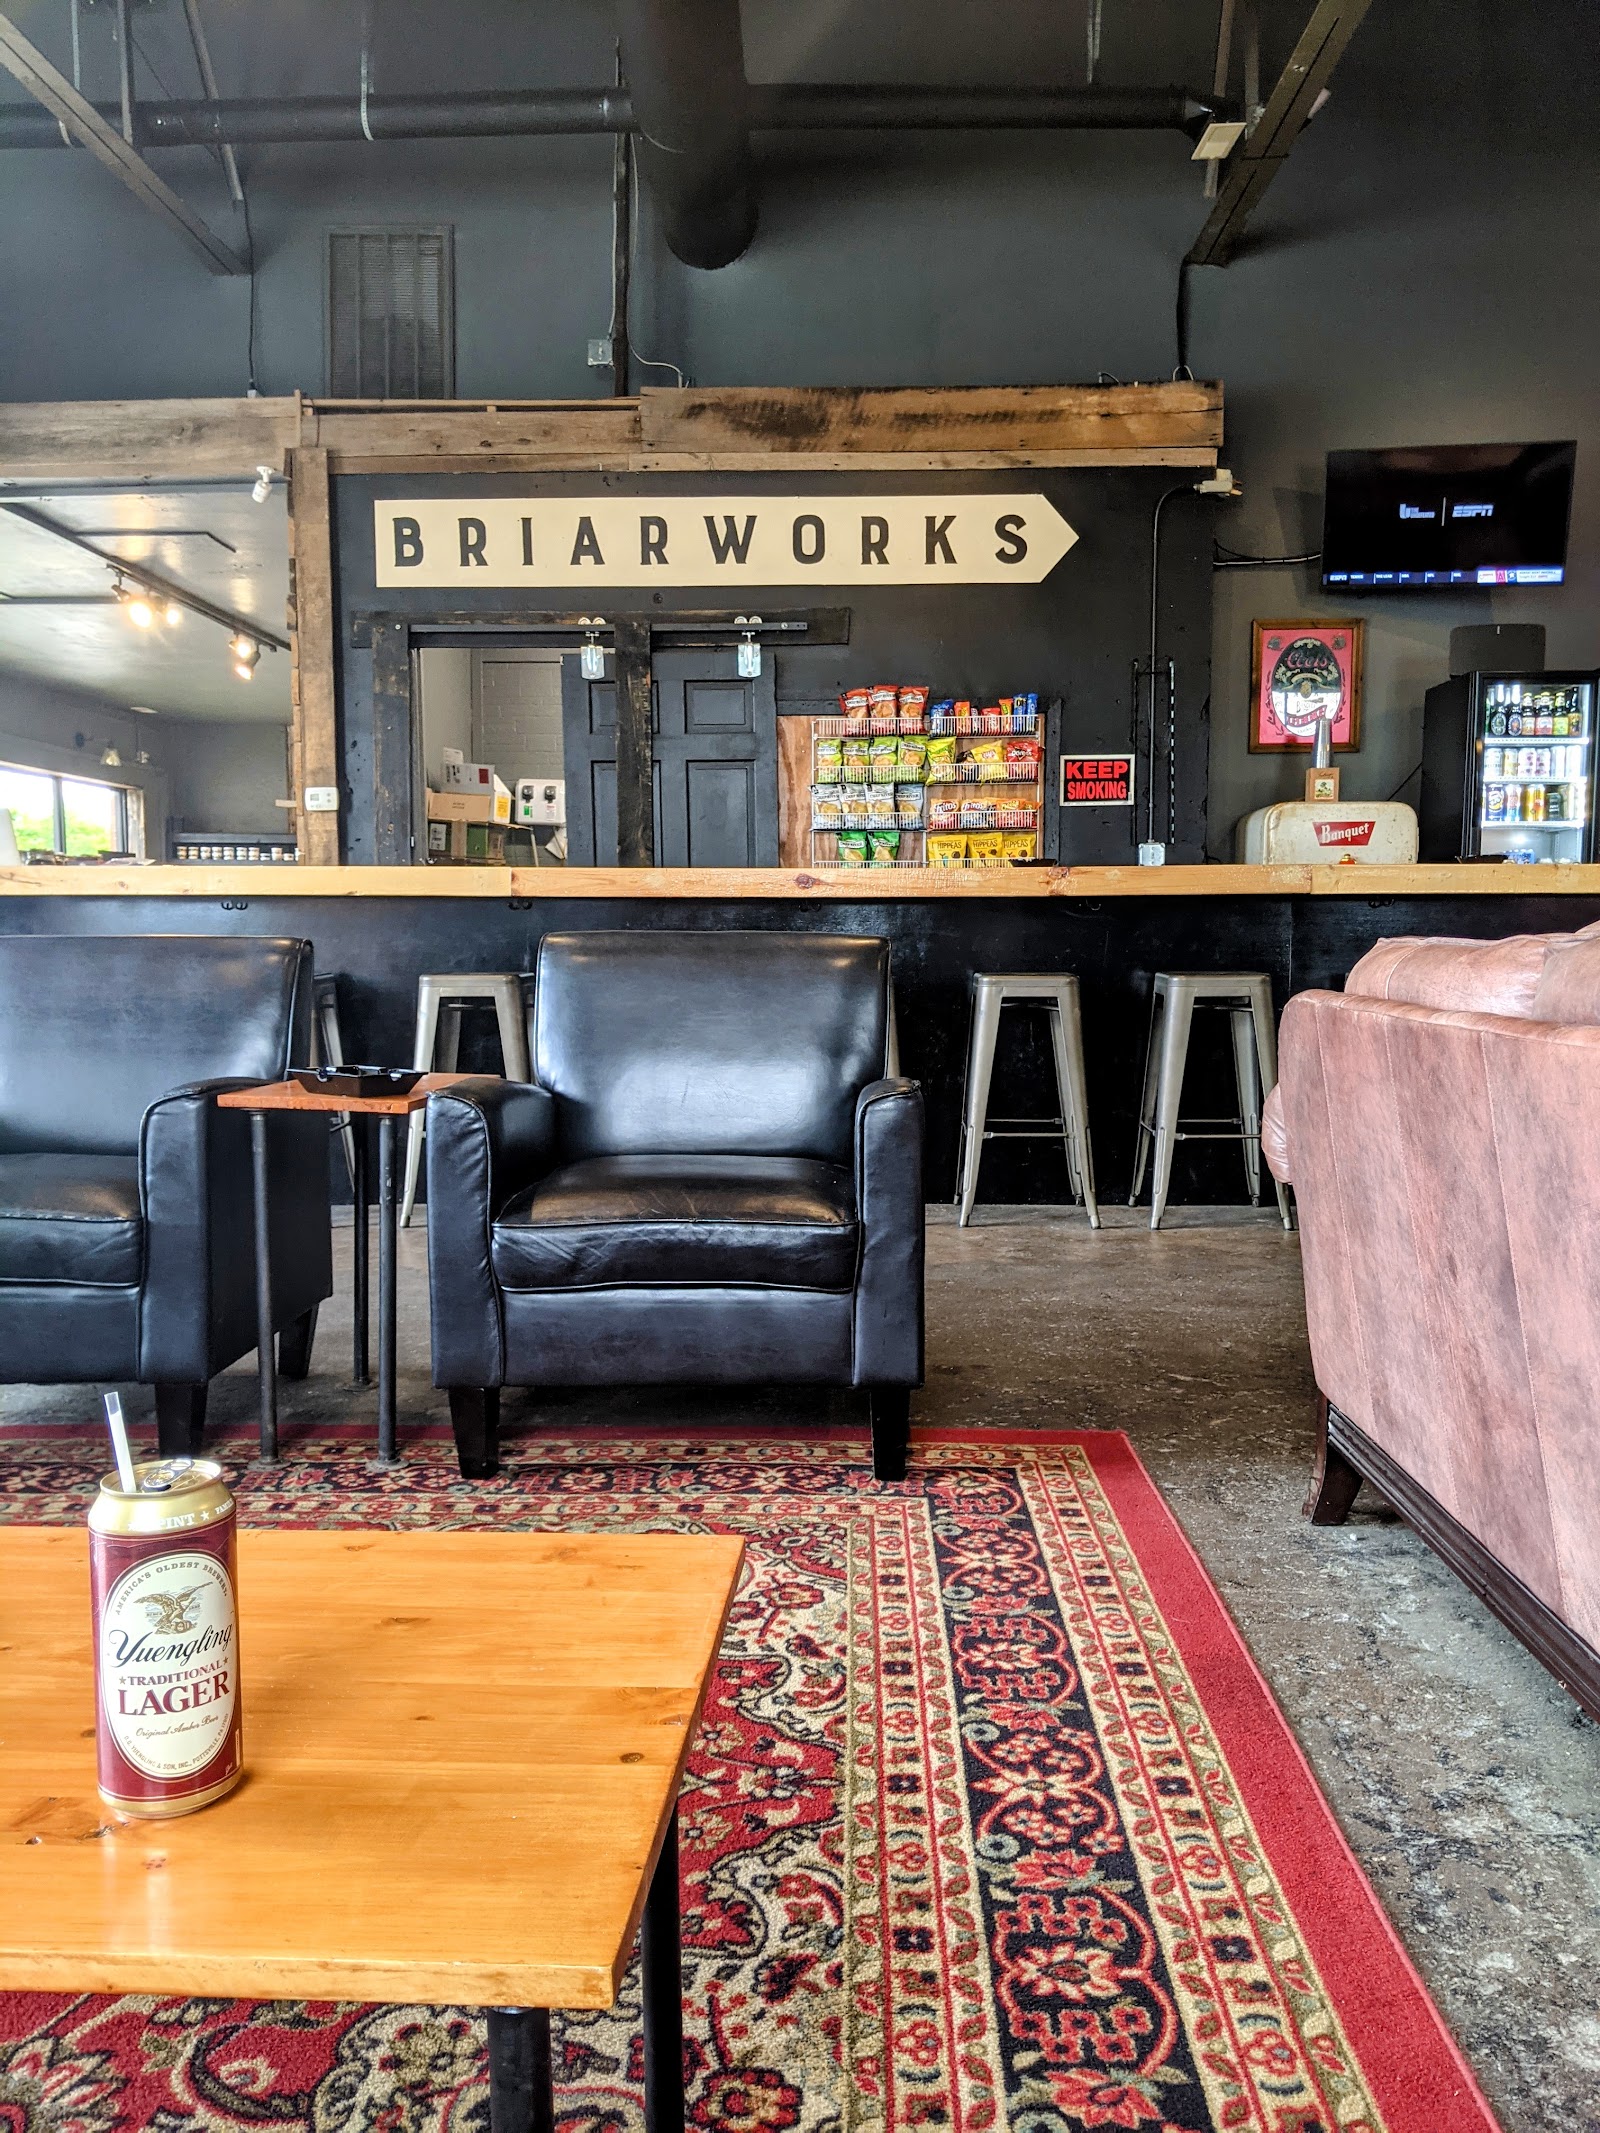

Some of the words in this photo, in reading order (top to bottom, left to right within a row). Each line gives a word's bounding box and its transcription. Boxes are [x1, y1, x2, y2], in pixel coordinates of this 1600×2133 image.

[1452, 504, 1494, 518] ESPN
[393, 514, 1029, 568] BRIARWORKS
[1066, 761, 1128, 779] KEEP
[1067, 780, 1127, 800] SMOKING
[972, 839, 998, 848] HIPPEAS
[1321, 823, 1370, 844] Banquet
[937, 841, 961, 849] HIPPEAS
[1003, 840, 1029, 849] HIPPEAS
[115, 1572, 151, 1615] AMERICA'S
[156, 1561, 200, 1573] OLDEST
[108, 1623, 233, 1668] Yuengling
[127, 1660, 223, 1686] TRADITIONAL
[118, 1670, 230, 1716] LAGER
[135, 1726, 169, 1740] Original
[170, 1720, 200, 1735] Amber
[131, 1745, 156, 1767] YUENGLING
